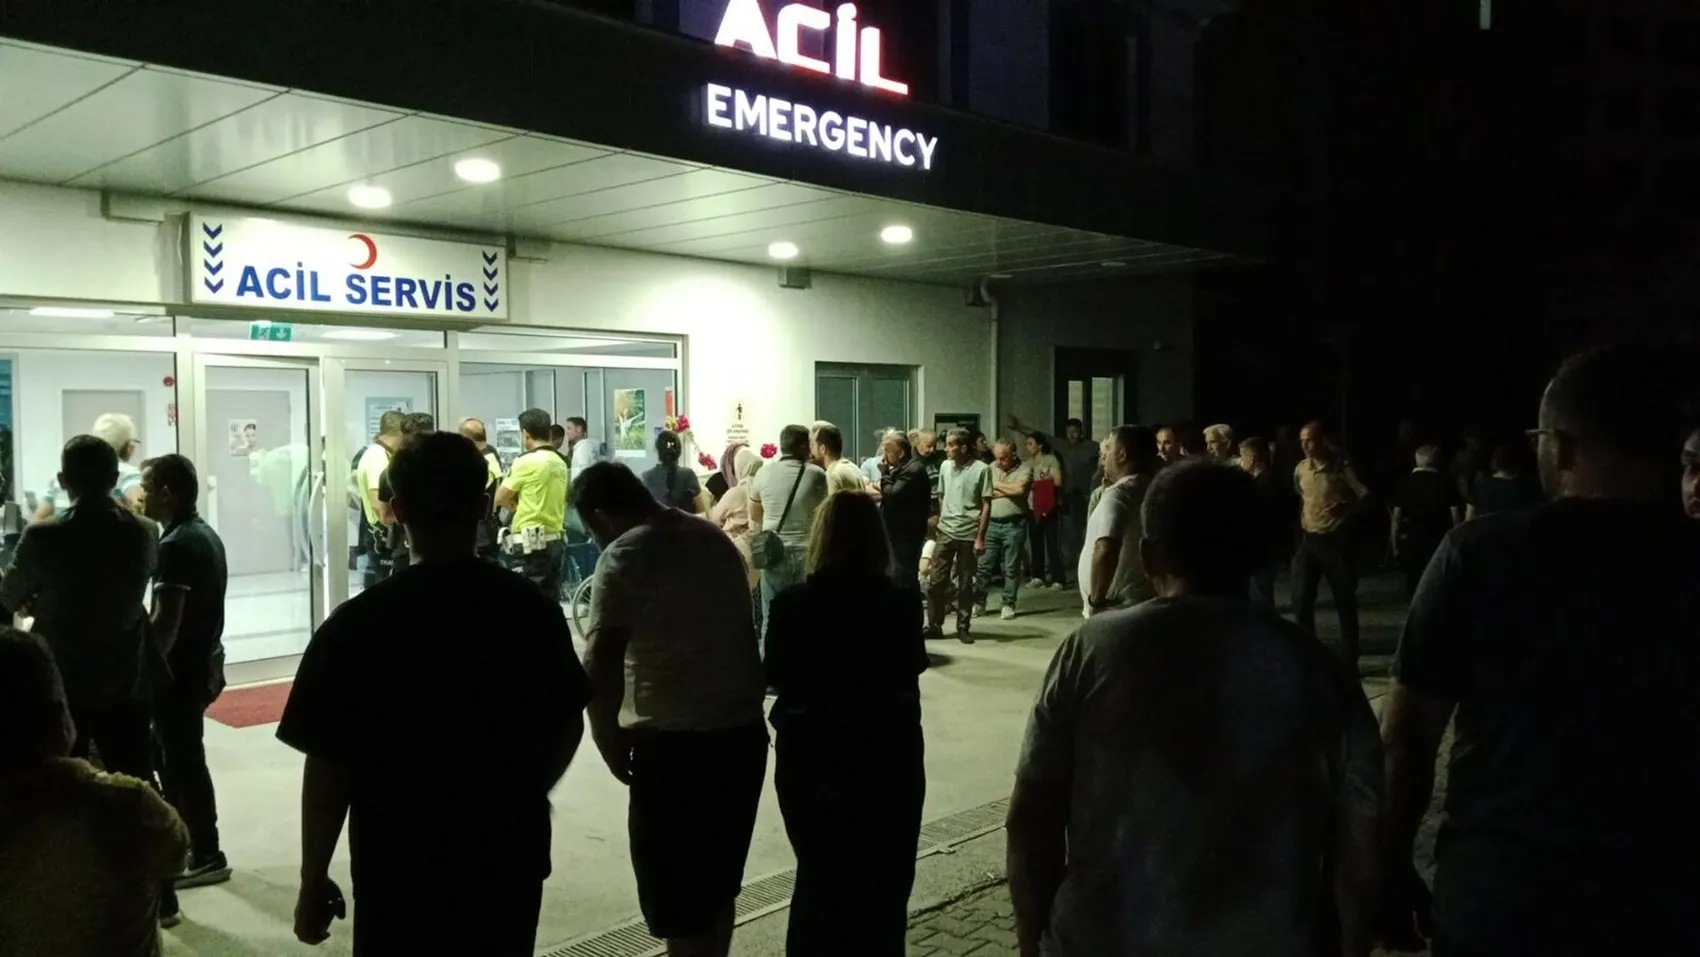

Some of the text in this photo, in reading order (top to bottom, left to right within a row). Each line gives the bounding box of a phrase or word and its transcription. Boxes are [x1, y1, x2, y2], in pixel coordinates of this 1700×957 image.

[714, 0, 909, 95] ACİL
[707, 83, 938, 170] EMERGENCY
[236, 262, 476, 312] ACİL SERVİS
